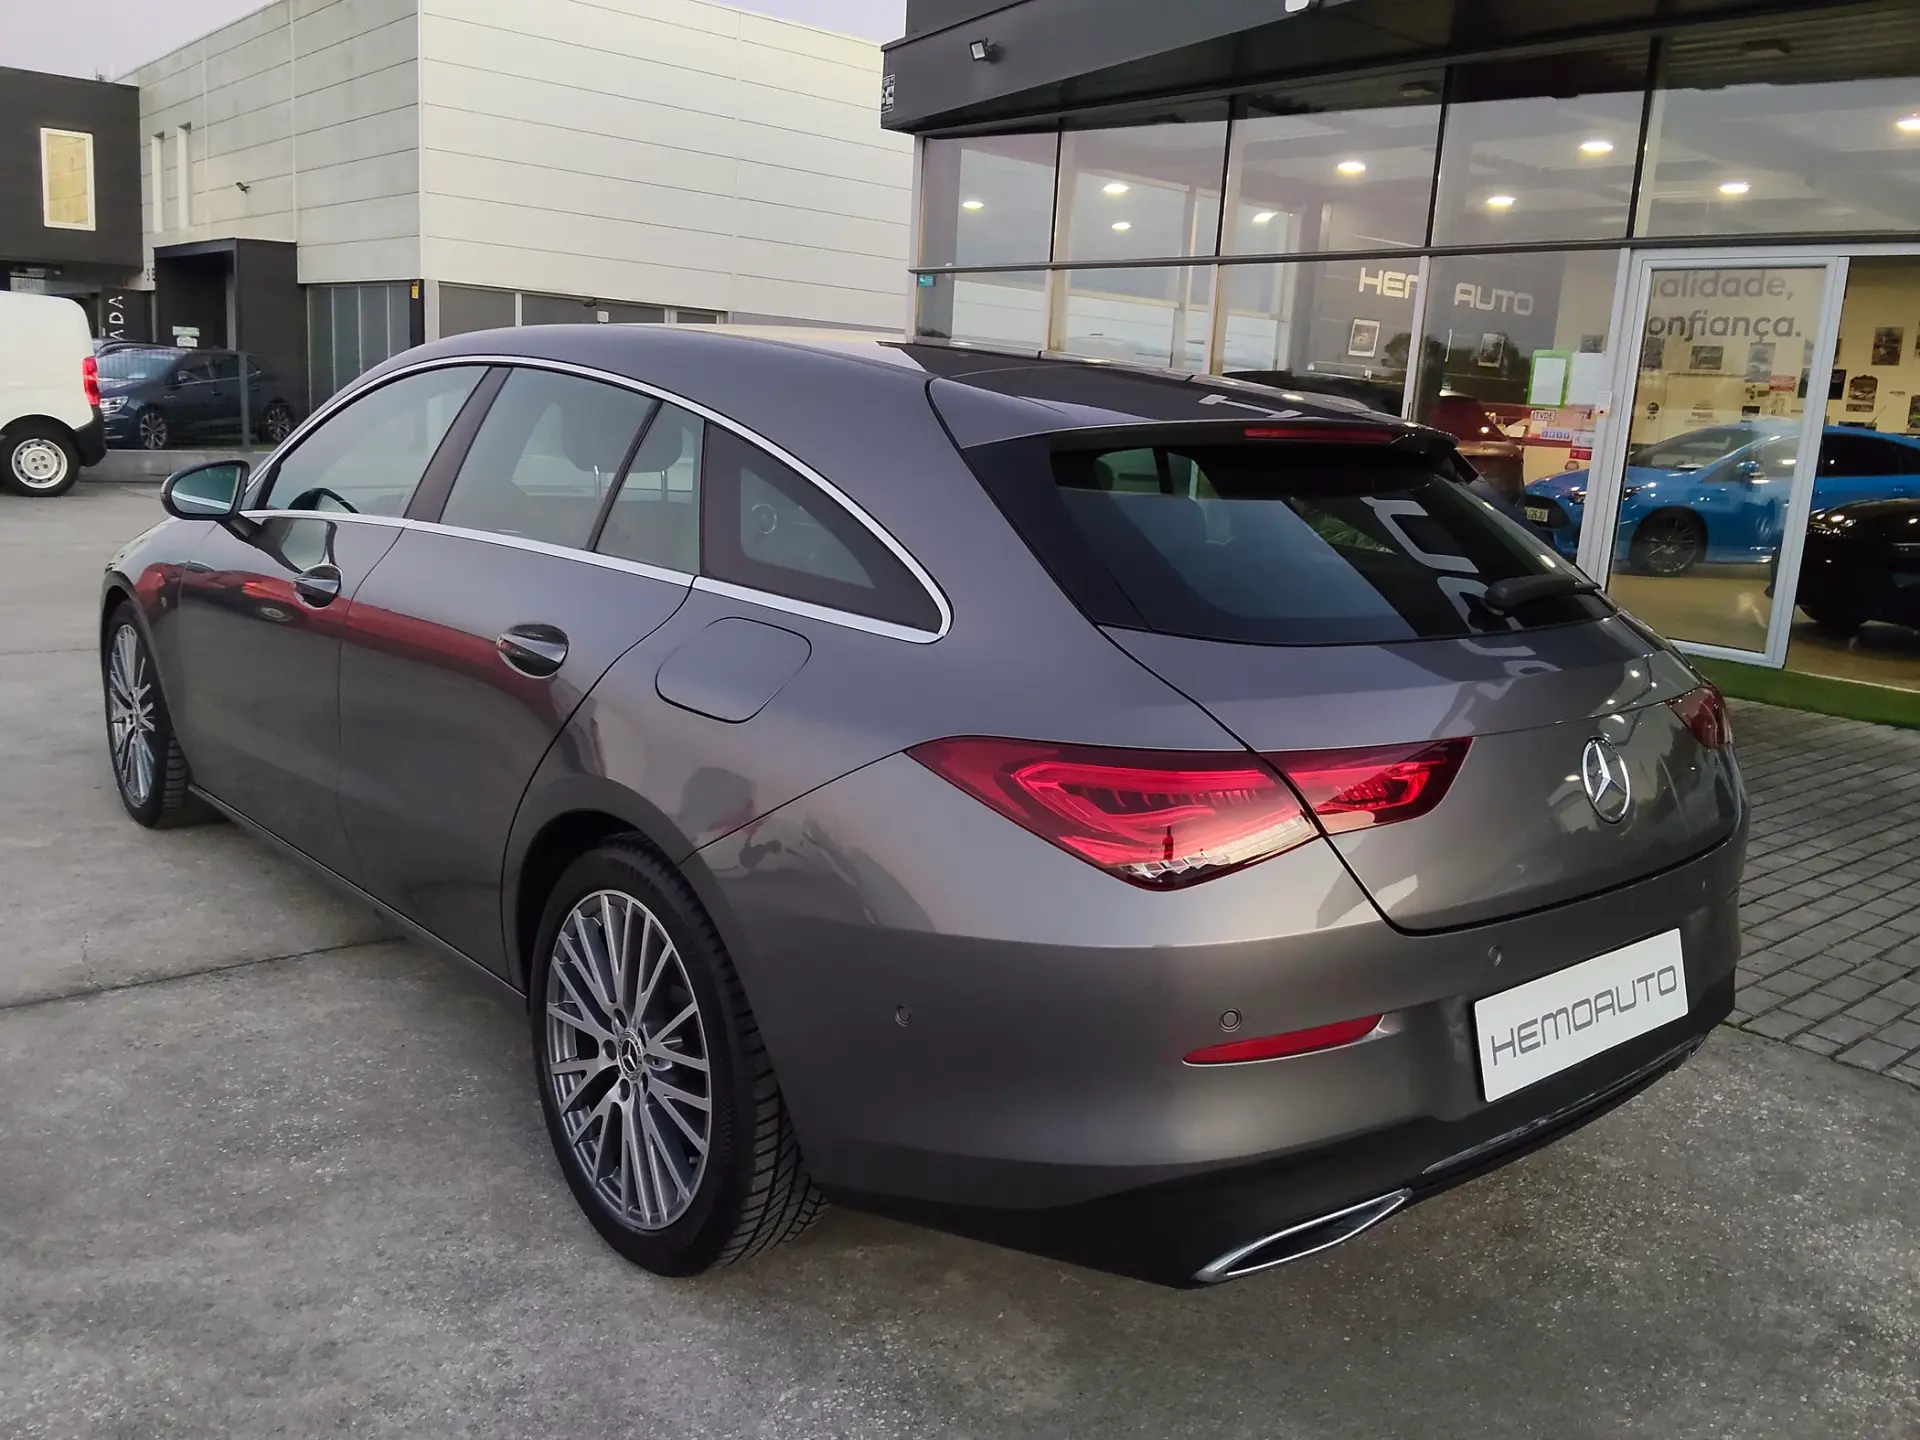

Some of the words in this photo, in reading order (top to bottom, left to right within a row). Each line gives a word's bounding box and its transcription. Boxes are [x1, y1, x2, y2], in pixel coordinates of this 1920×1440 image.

[1454, 283, 1534, 316] AUTO
[1648, 309, 1802, 344] onfiança.
[1491, 965, 1678, 1066] HEMOAUTO
